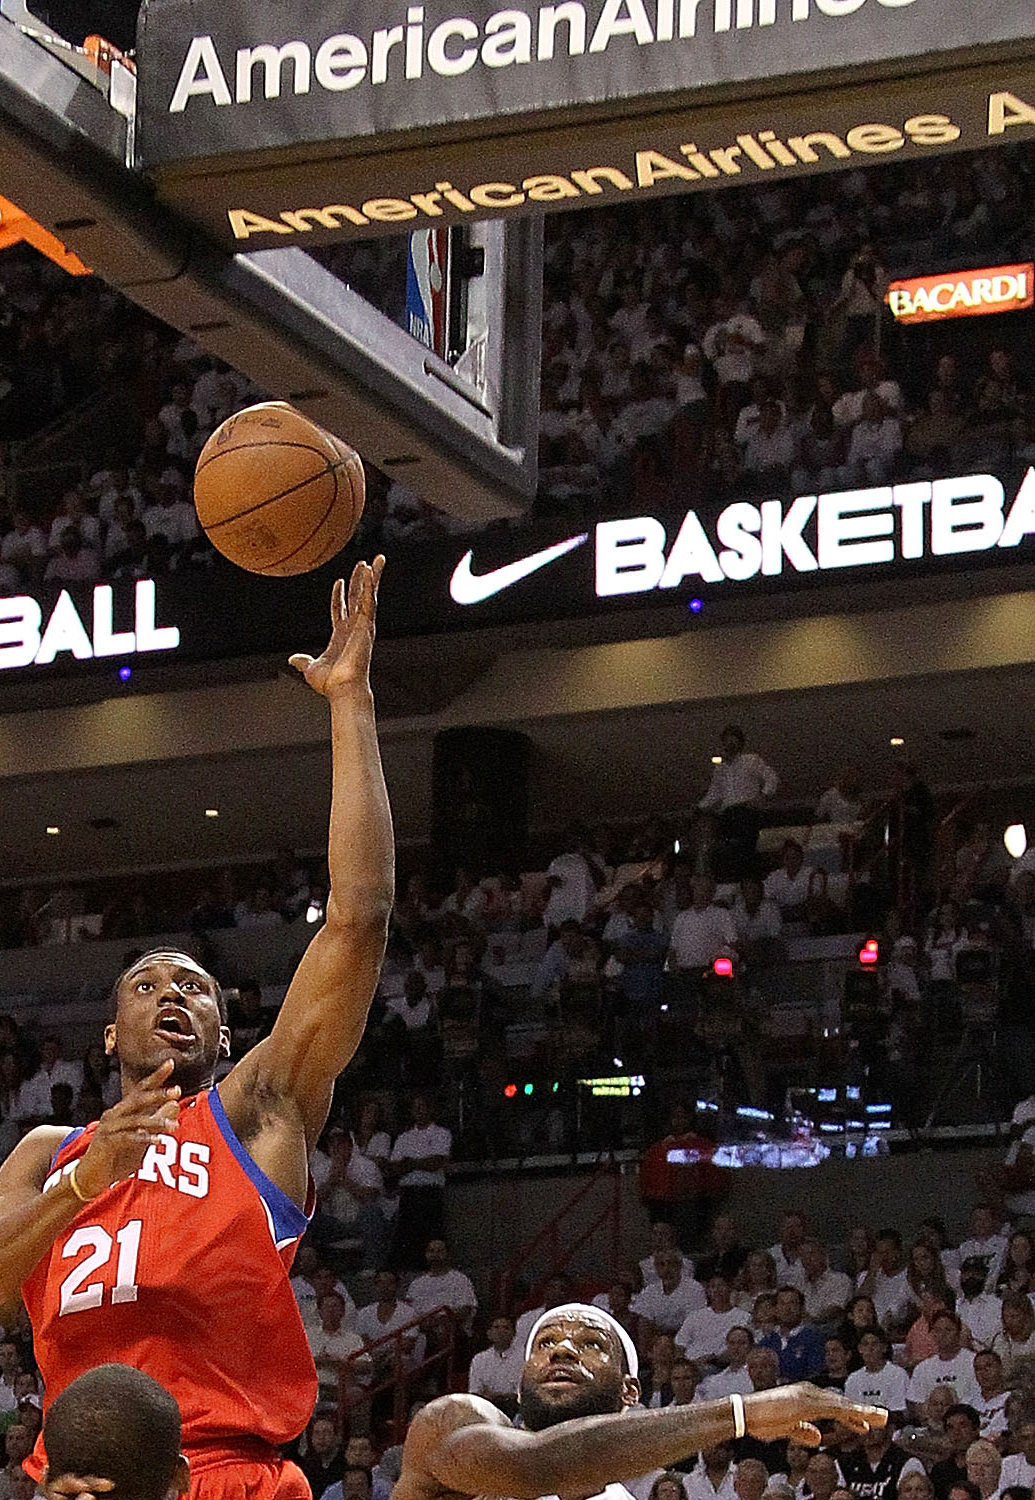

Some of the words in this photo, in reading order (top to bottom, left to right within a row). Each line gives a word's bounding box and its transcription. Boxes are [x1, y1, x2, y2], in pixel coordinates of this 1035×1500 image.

[168, 0, 917, 112] AmericanAirn
[226, 113, 961, 239] AmericanAirlines
[888, 271, 1028, 318] BACARDI
[59, 1218, 143, 1317] 21
